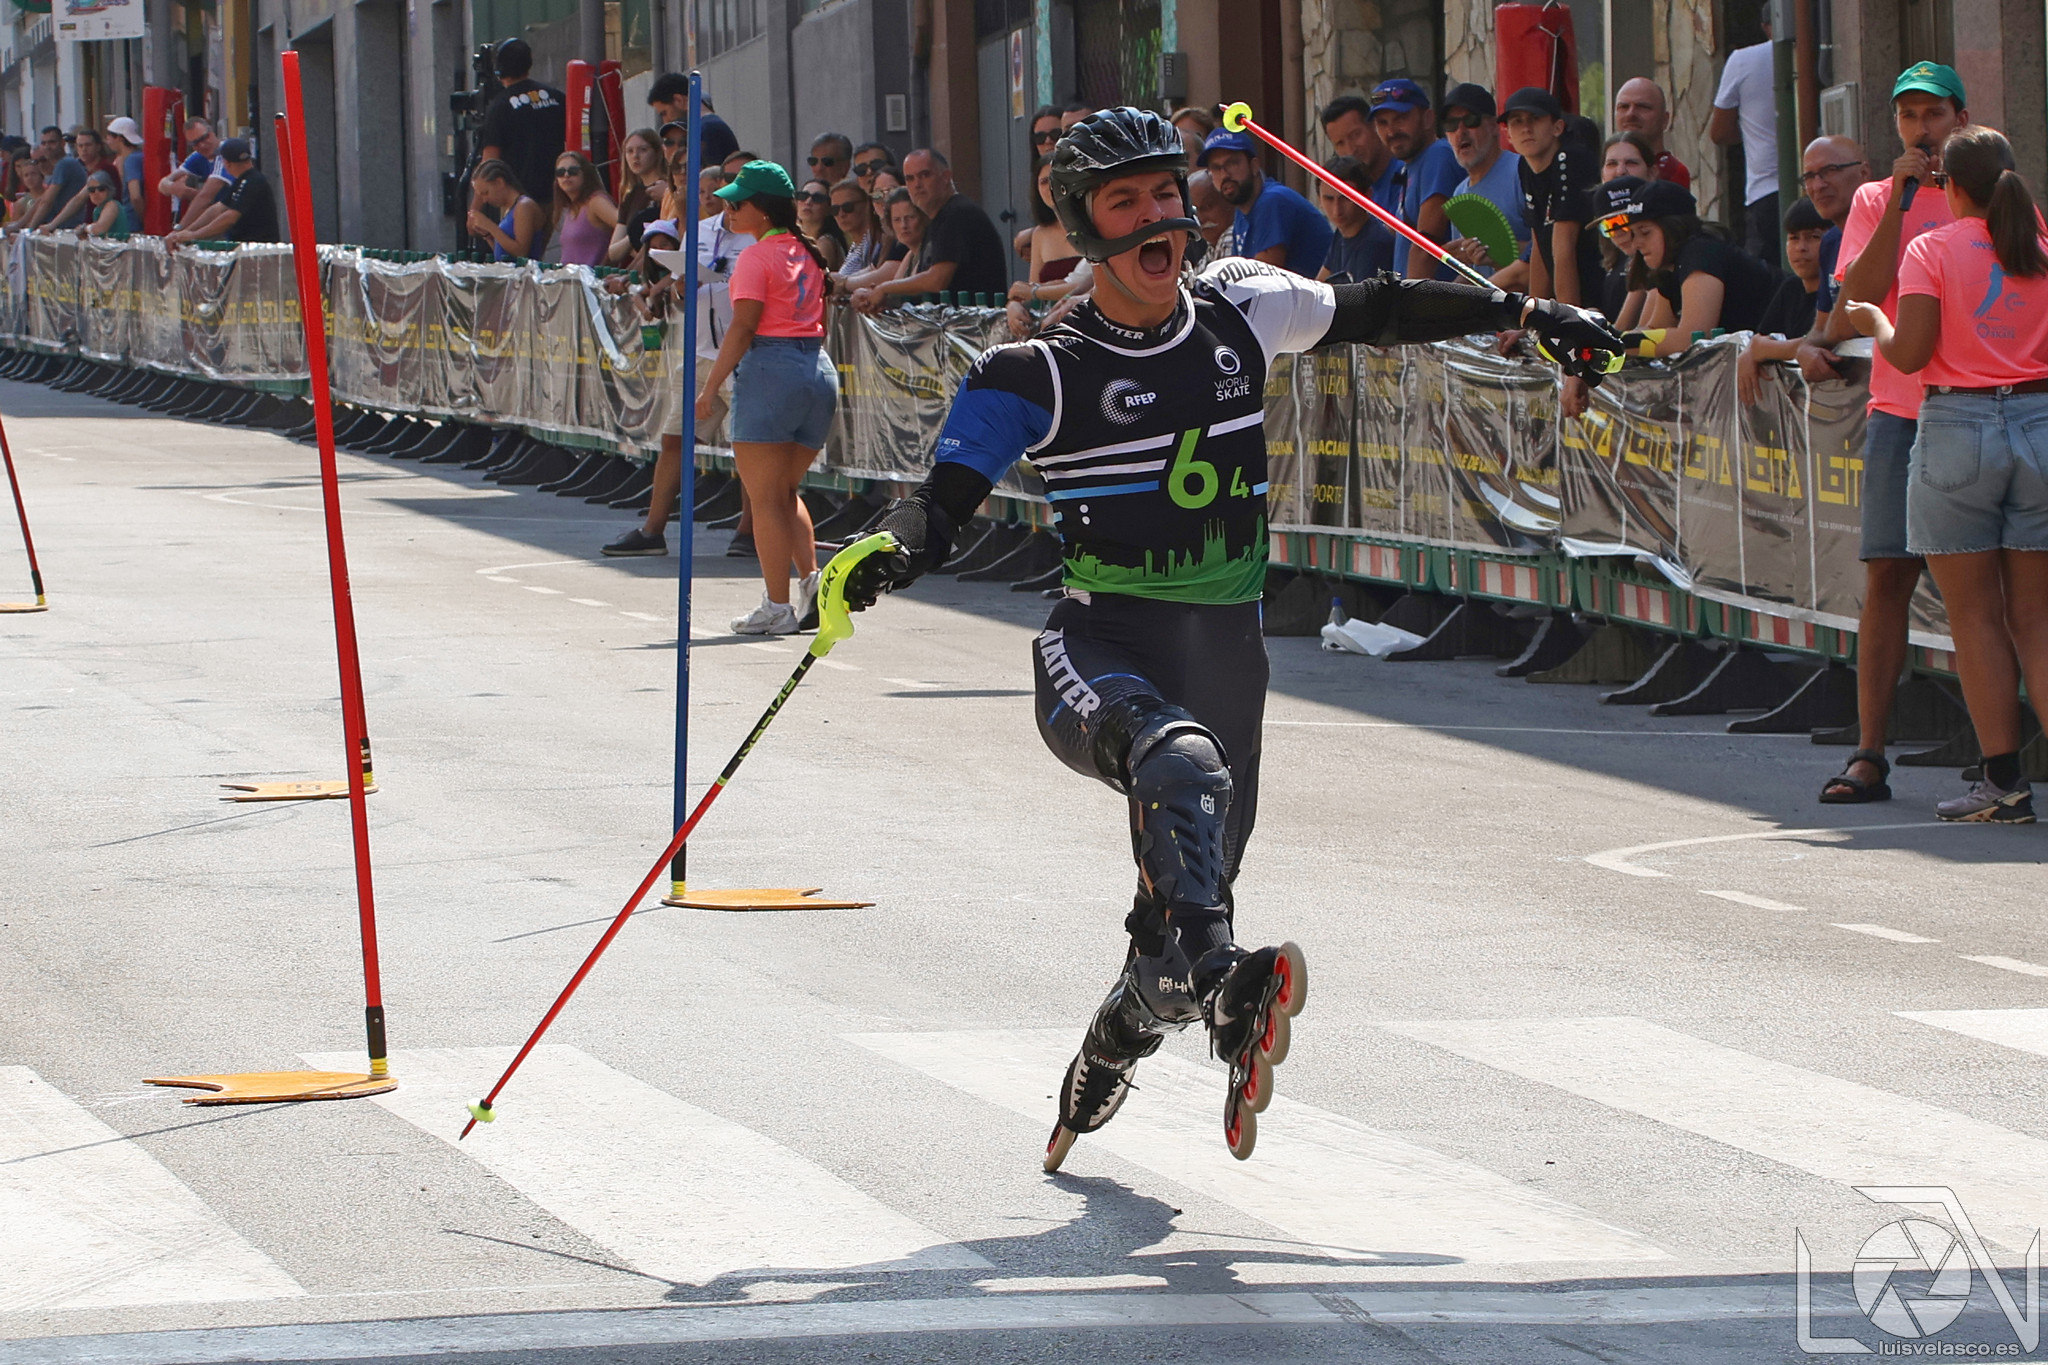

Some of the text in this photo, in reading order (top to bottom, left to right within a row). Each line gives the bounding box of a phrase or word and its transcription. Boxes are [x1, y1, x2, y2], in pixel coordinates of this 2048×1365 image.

[1214, 375, 1250, 391] WORLD
[1124, 392, 1157, 408] RFEP
[1216, 385, 1250, 402] SKATE
[1168, 427, 1250, 510] 6 4
[1816, 439, 1864, 508] LEIT
[820, 565, 839, 612] LEKI
[1090, 1053, 1123, 1070] ARISE
